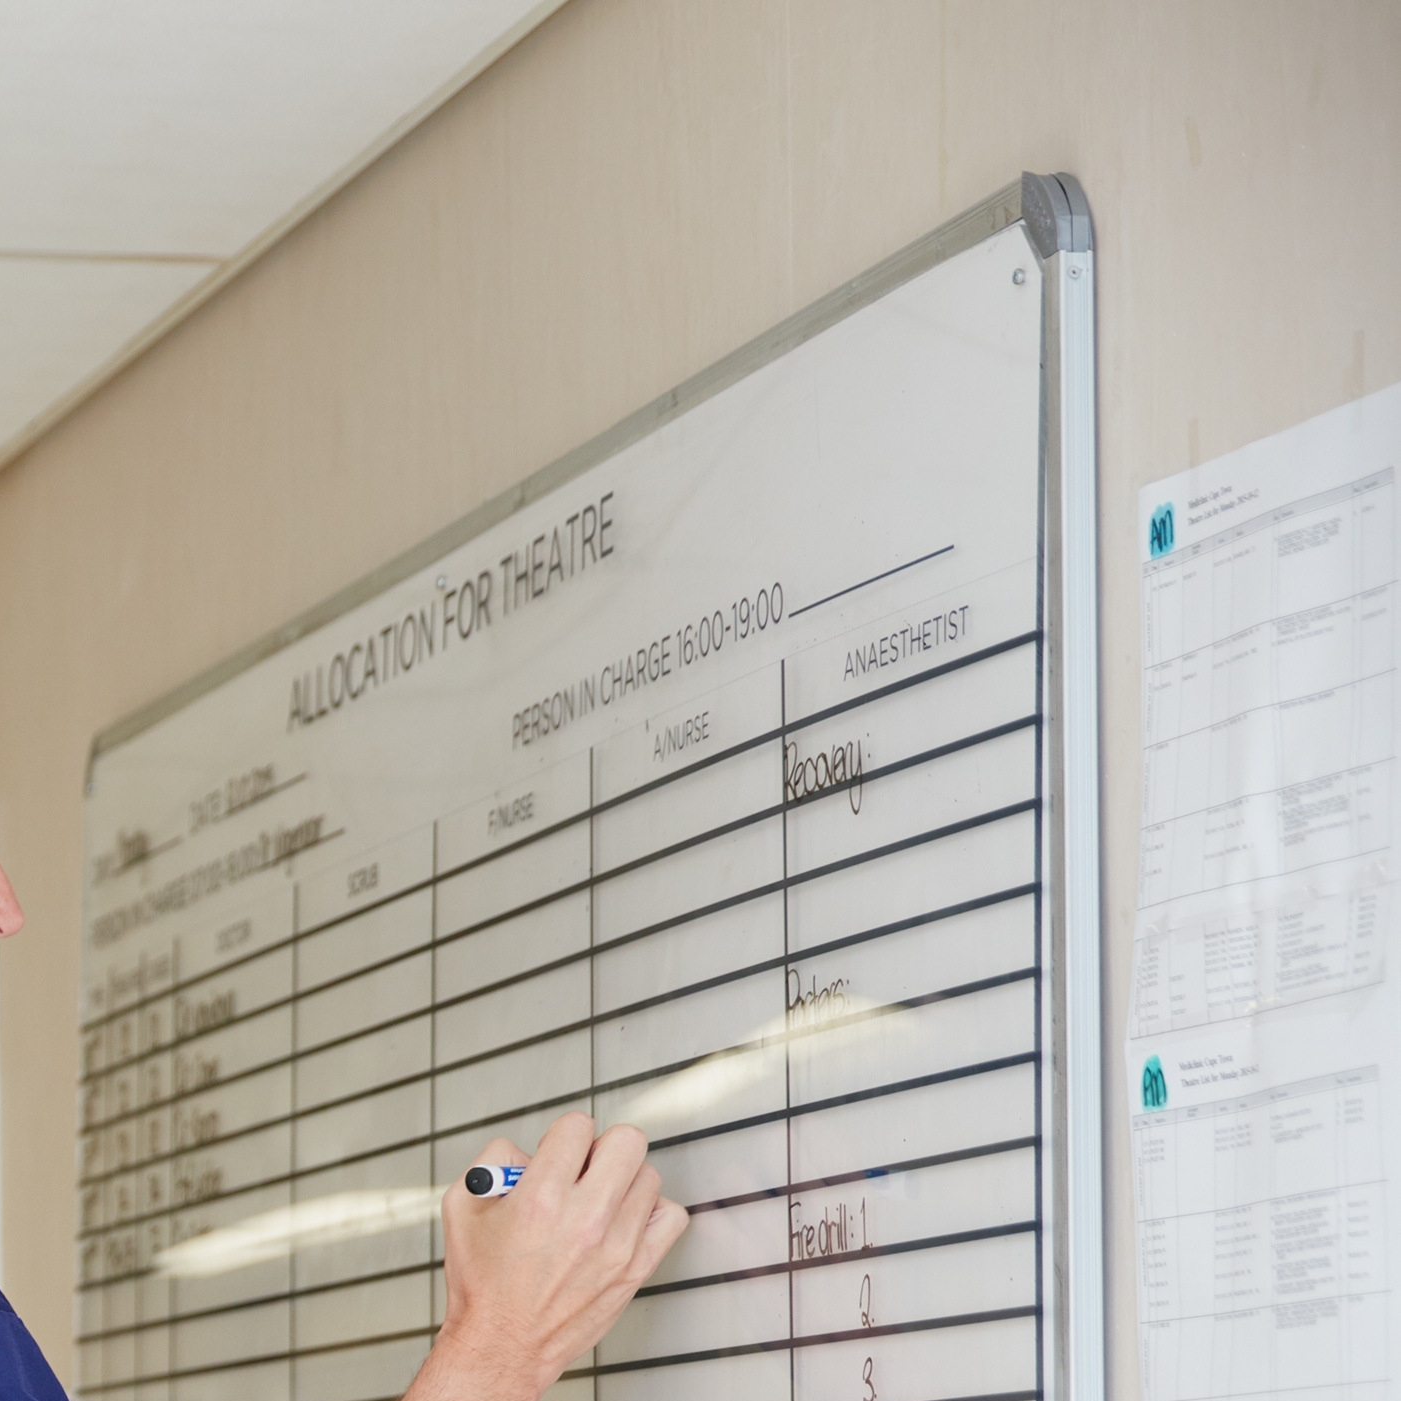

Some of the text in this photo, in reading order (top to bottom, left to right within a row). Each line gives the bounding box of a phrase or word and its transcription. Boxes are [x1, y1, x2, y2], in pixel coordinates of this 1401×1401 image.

[1150, 509, 1174, 555] AM
[286, 491, 614, 735] ALLOCATION FOR THEATRE
[512, 582, 784, 750] PERSON IN CHARGE 16:00-19:00
[842, 605, 970, 681] ANAESTHETIST
[651, 711, 711, 763] A/NURSE
[487, 791, 535, 838] F/NURSE
[348, 862, 380, 899] SCRUB
